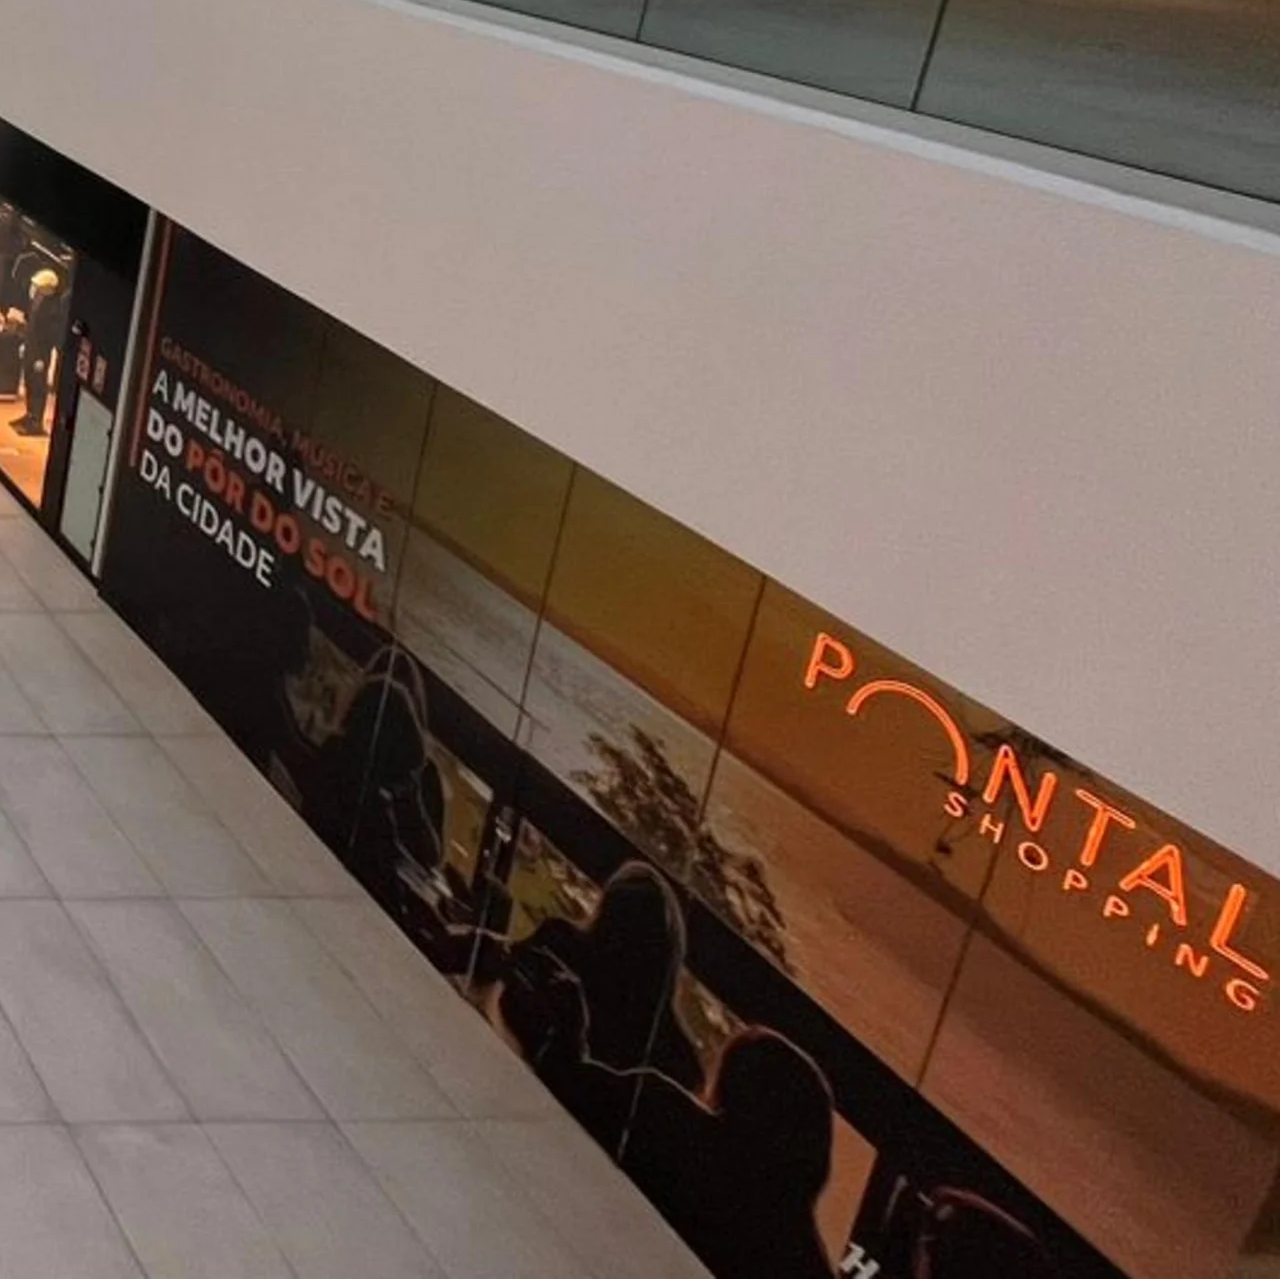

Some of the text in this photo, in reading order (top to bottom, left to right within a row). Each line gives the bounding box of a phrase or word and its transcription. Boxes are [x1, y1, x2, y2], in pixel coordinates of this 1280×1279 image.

[140, 451, 275, 588] DA CIDADE
[146, 407, 184, 457] DO
[250, 489, 301, 554] DO
[303, 536, 382, 620] SOL
[152, 369, 386, 572] A MELHOR VISTA
[943, 792, 1261, 1012] SHOPPING
